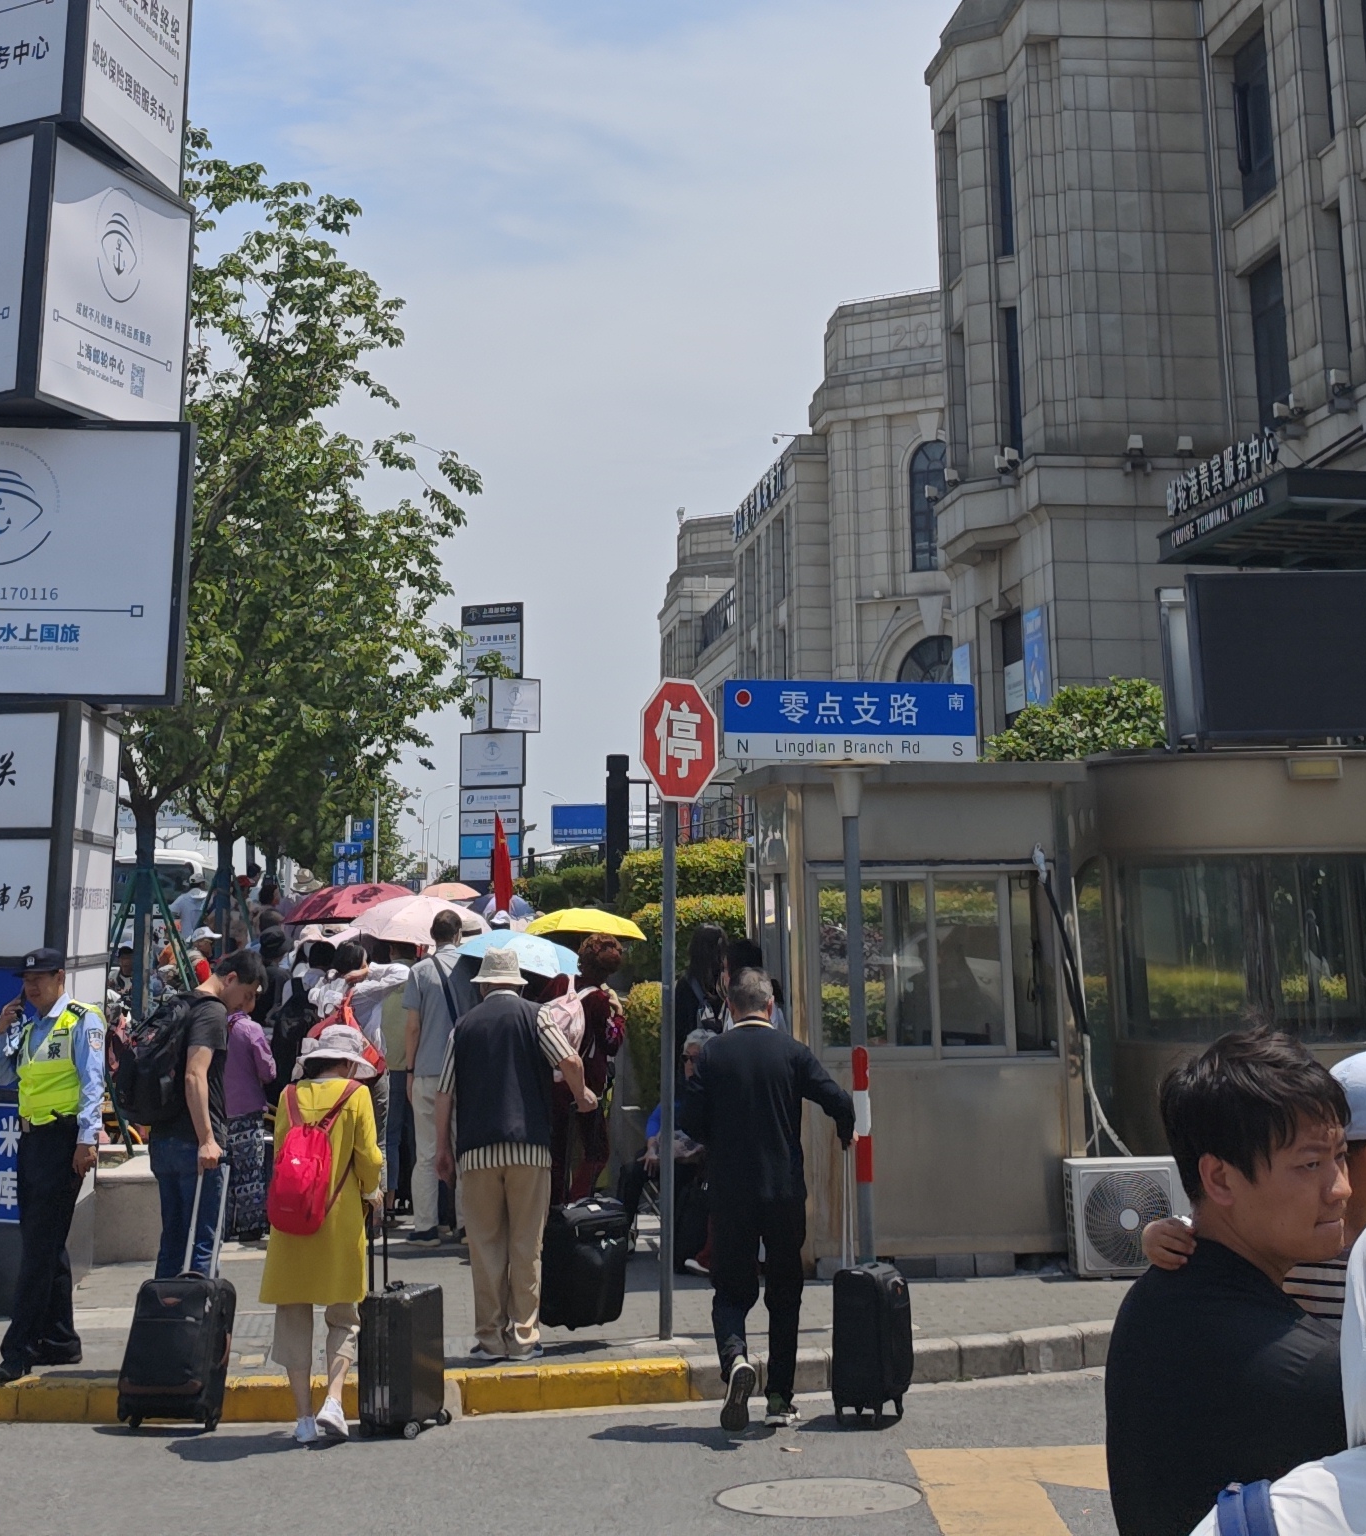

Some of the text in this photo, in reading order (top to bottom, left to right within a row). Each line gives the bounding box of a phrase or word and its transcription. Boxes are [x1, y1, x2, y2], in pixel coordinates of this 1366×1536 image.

[92, 39, 175, 133] 邮轮保险理赔服务中心
[76, 302, 152, 346] 成就不凡创想 构筑品质服务
[77, 340, 125, 375] 上海邮轮中心
[1167, 433, 1279, 517] 邮轮港贵宾服务中心
[1171, 522, 1195, 548] CRUISE
[1195, 505, 1229, 535] TERMINAL
[1244, 487, 1264, 512] AREA
[779, 690, 919, 726] 零点支路
[947, 693, 965, 711] 南
[655, 700, 702, 778] 停
[737, 739, 749, 753] N
[775, 738, 920, 757] Lingdian Branch Rd
[952, 742, 963, 756] S
[47, 1042, 62, 1059] 察
